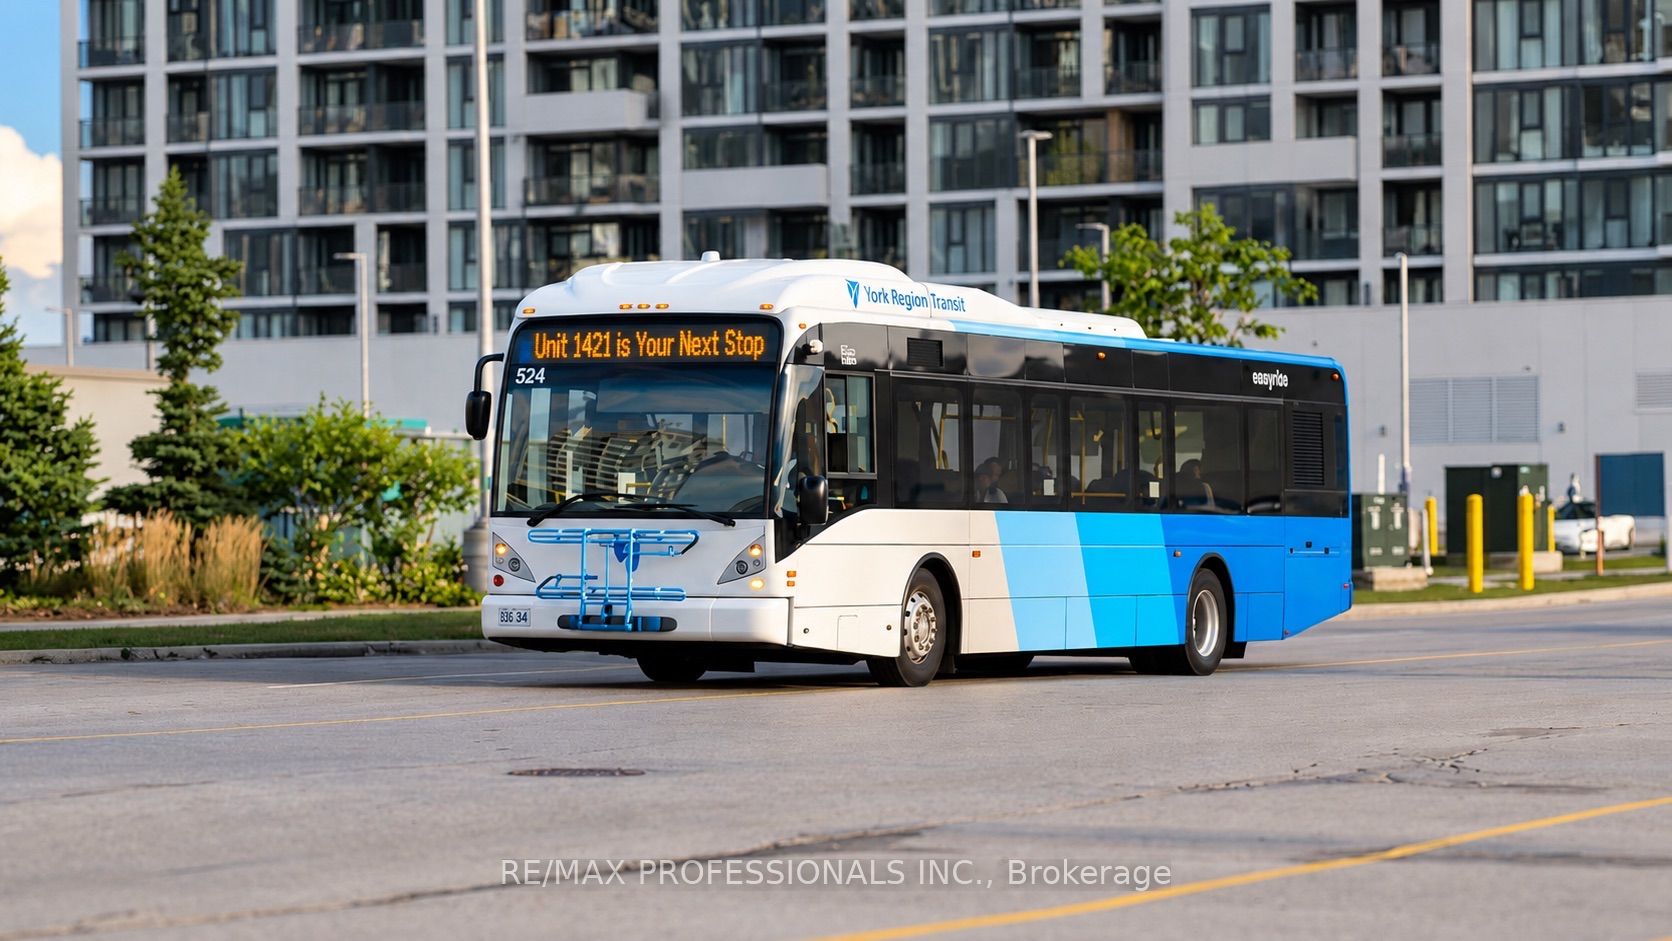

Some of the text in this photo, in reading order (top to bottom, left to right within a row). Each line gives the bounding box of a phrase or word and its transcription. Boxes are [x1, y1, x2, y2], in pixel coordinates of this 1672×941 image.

[864, 285, 966, 312] York Region Transit
[534, 328, 765, 360] Unit 1421 is Your Next Stop
[515, 367, 546, 384] 524
[516, 611, 528, 623] 34
